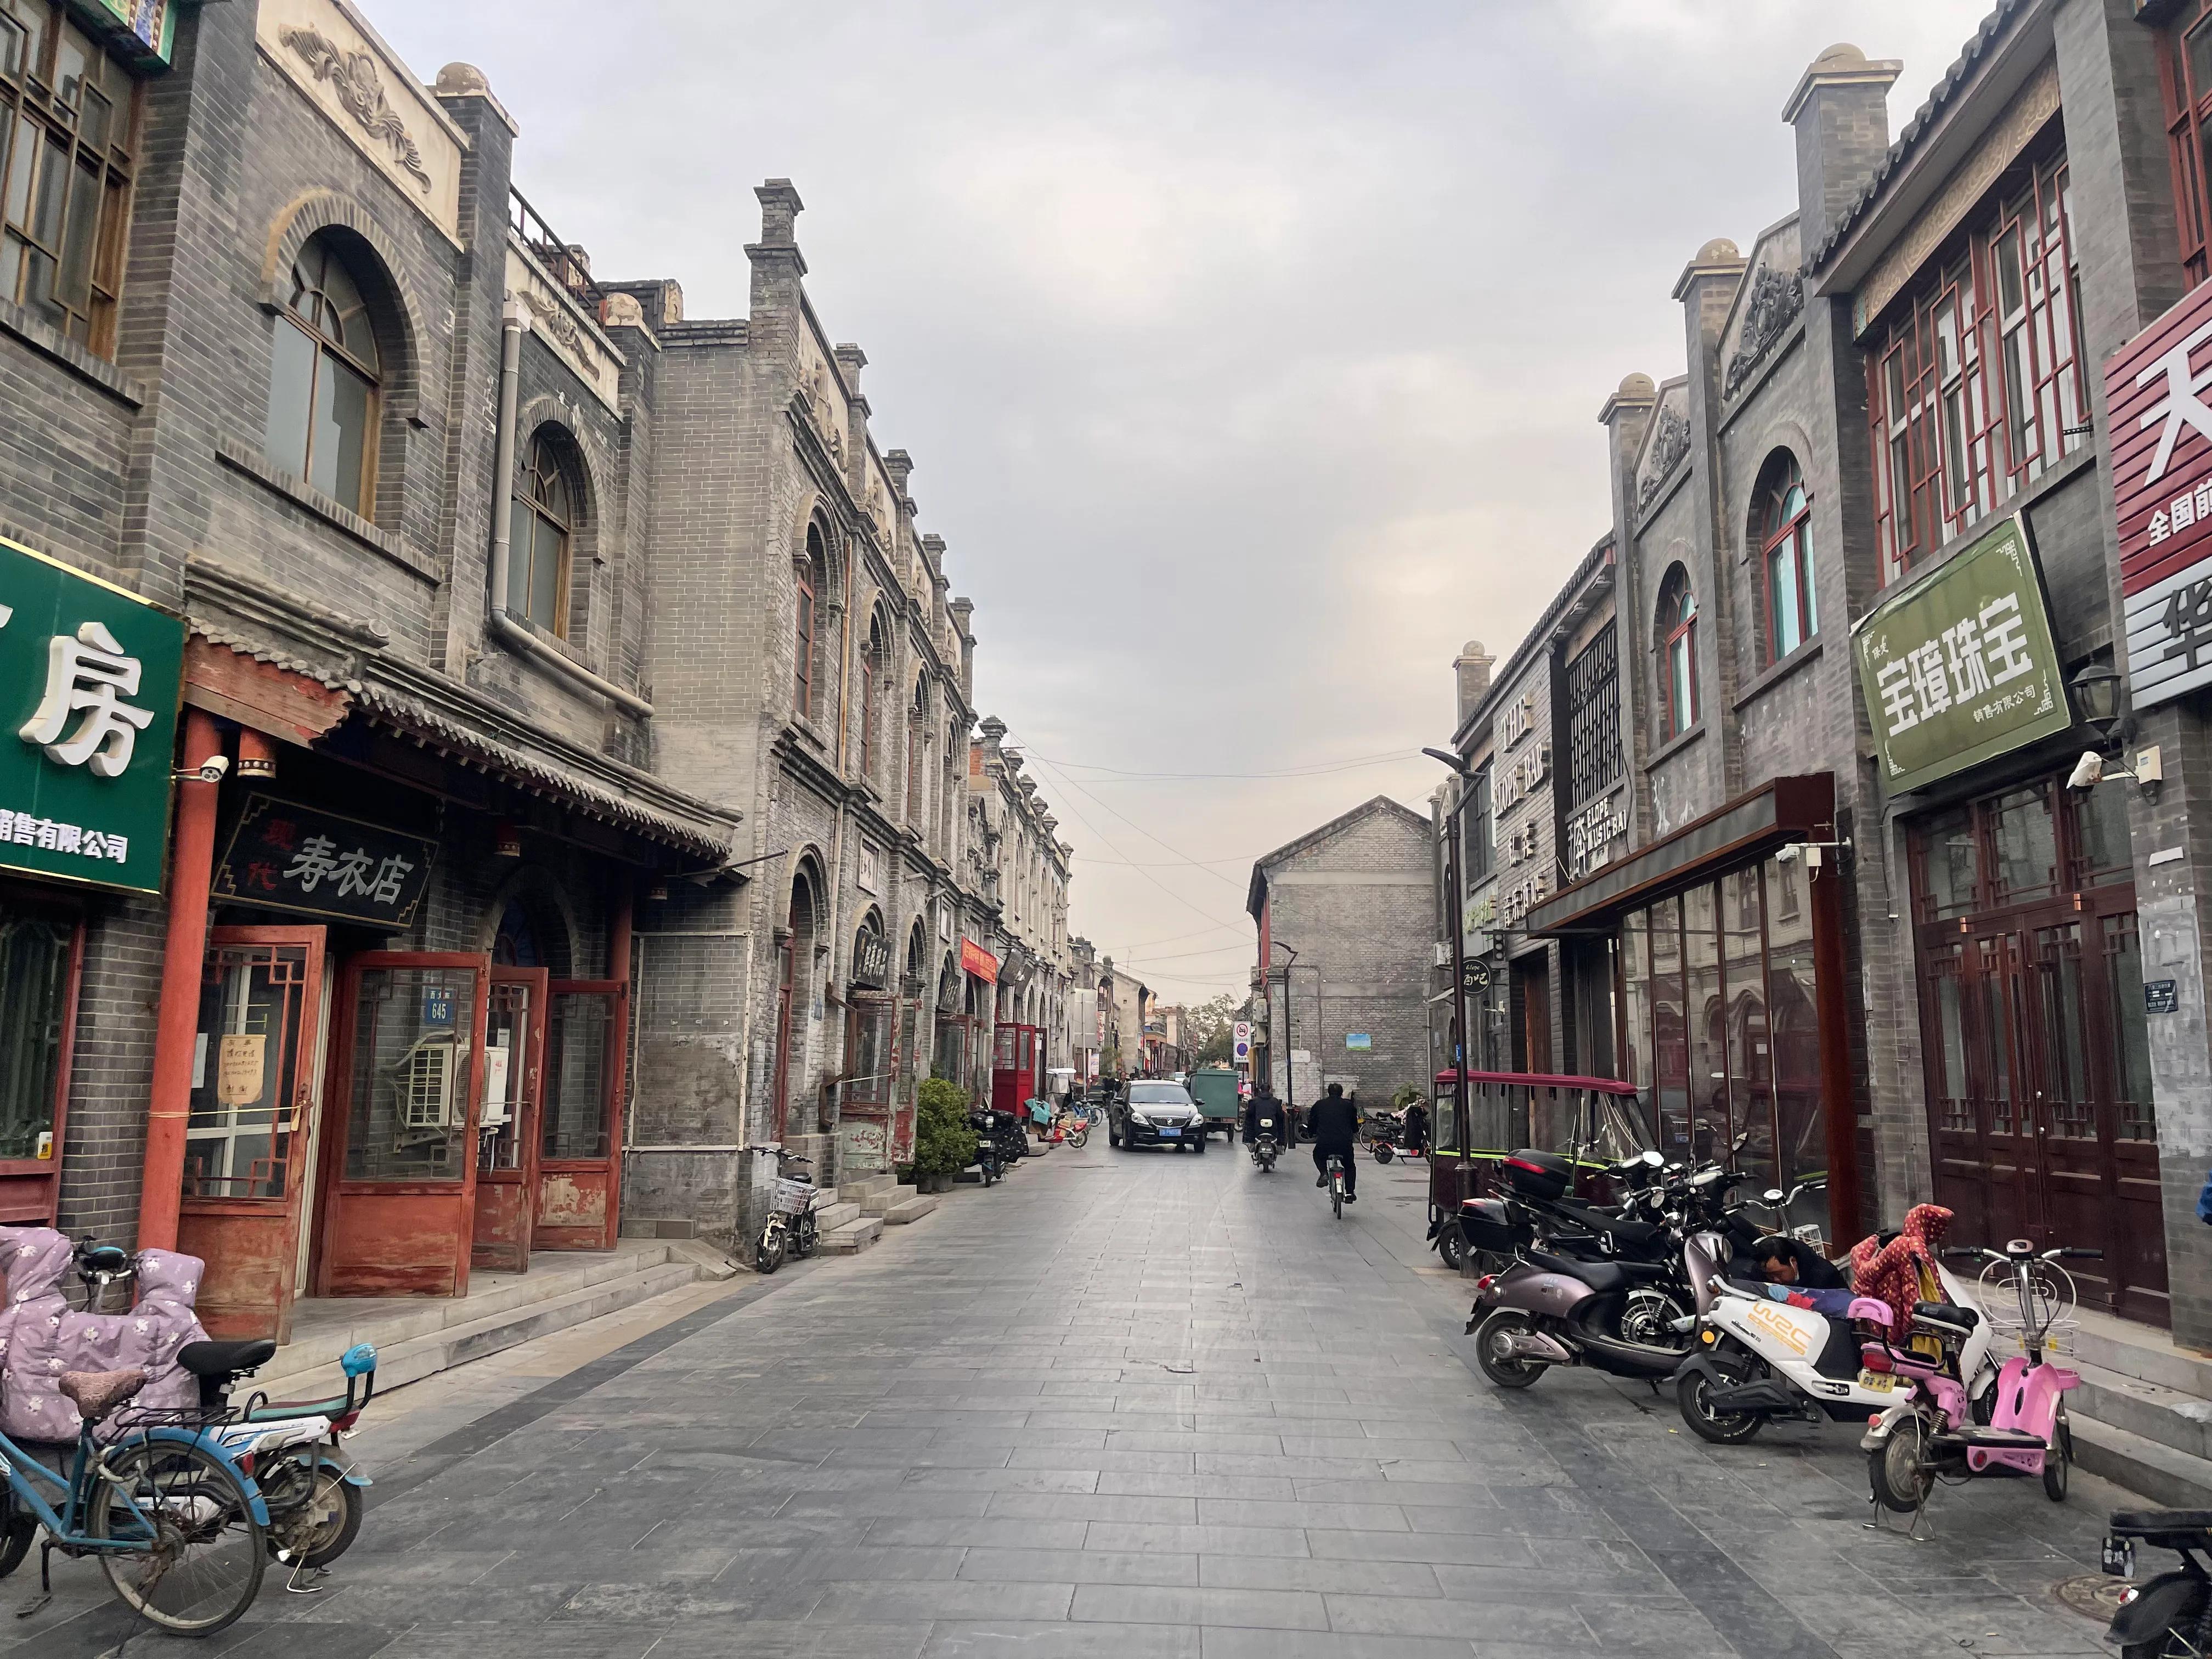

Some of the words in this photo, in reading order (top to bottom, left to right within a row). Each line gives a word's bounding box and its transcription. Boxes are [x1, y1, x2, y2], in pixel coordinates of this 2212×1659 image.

[0, 605, 155, 777] 房
[1973, 685, 2036, 723] 销售有限公司
[1500, 692, 1527, 753] THE
[1493, 764, 1519, 819] ELOPE
[1524, 742, 1544, 793] BAR
[1587, 797, 1609, 829] ELOPE
[1587, 819, 1611, 851] MUSIC
[283, 834, 415, 905] 寿衣店
[432, 1003, 447, 1019] 645
